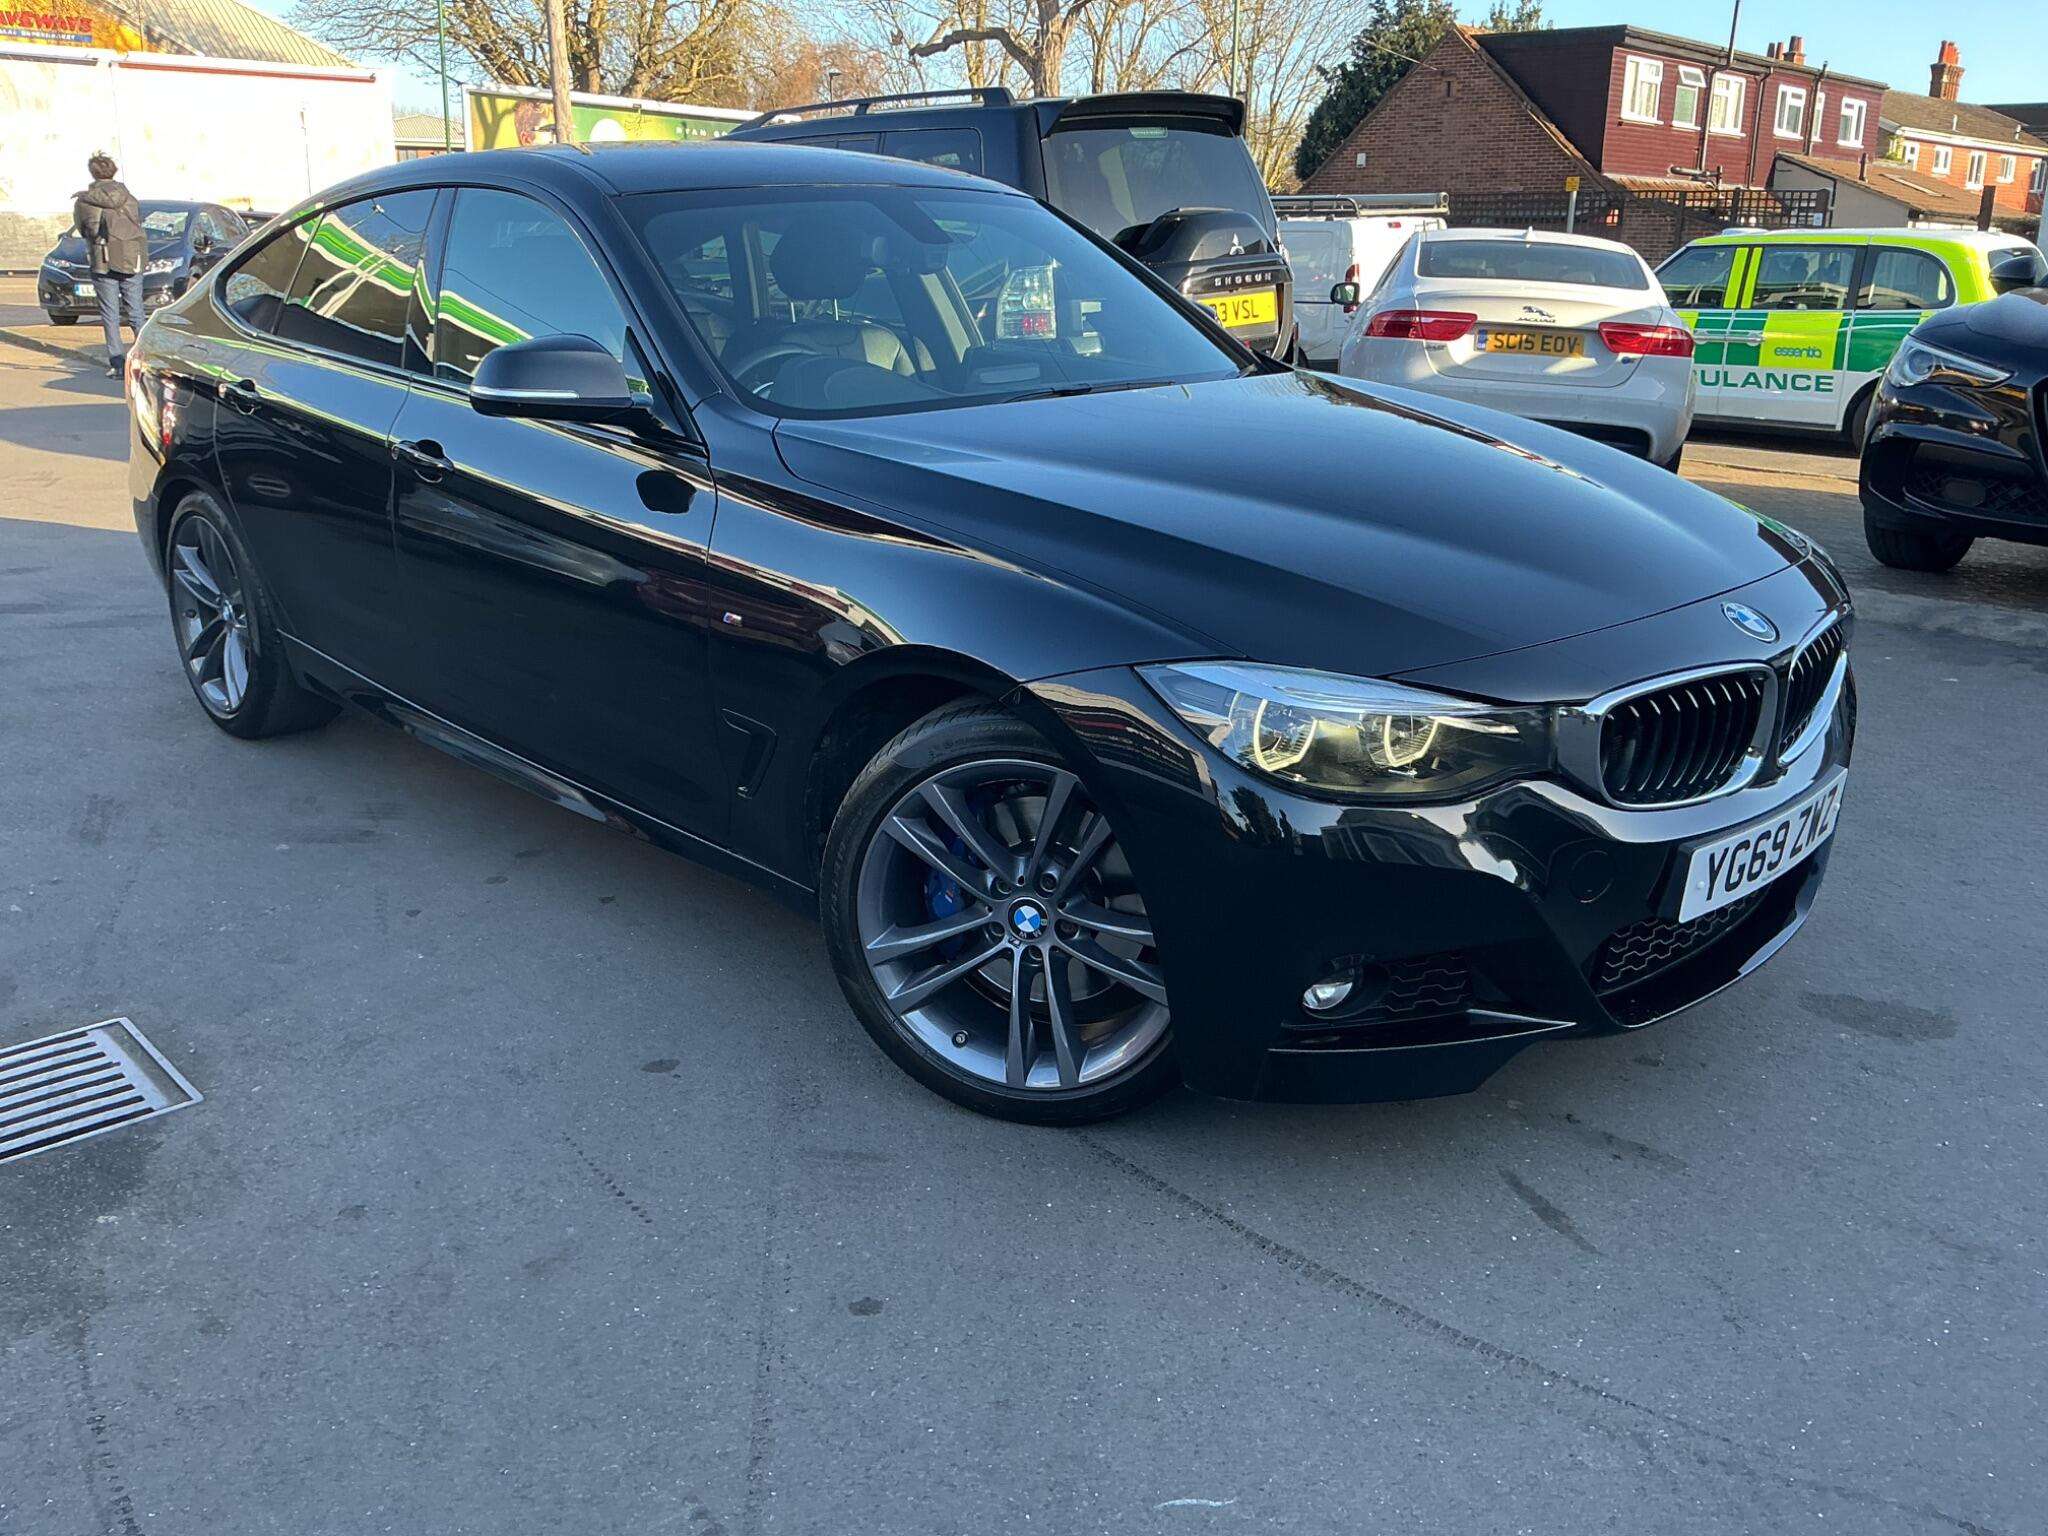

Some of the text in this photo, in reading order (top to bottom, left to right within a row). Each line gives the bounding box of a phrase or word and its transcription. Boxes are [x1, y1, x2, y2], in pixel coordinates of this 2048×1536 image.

[1214, 272, 1272, 286] SHOGUN
[1232, 299, 1259, 321] VSL
[1493, 331, 1534, 351] SC15
[1693, 368, 1834, 393] ULANCE
[1706, 820, 1791, 901] YG69
